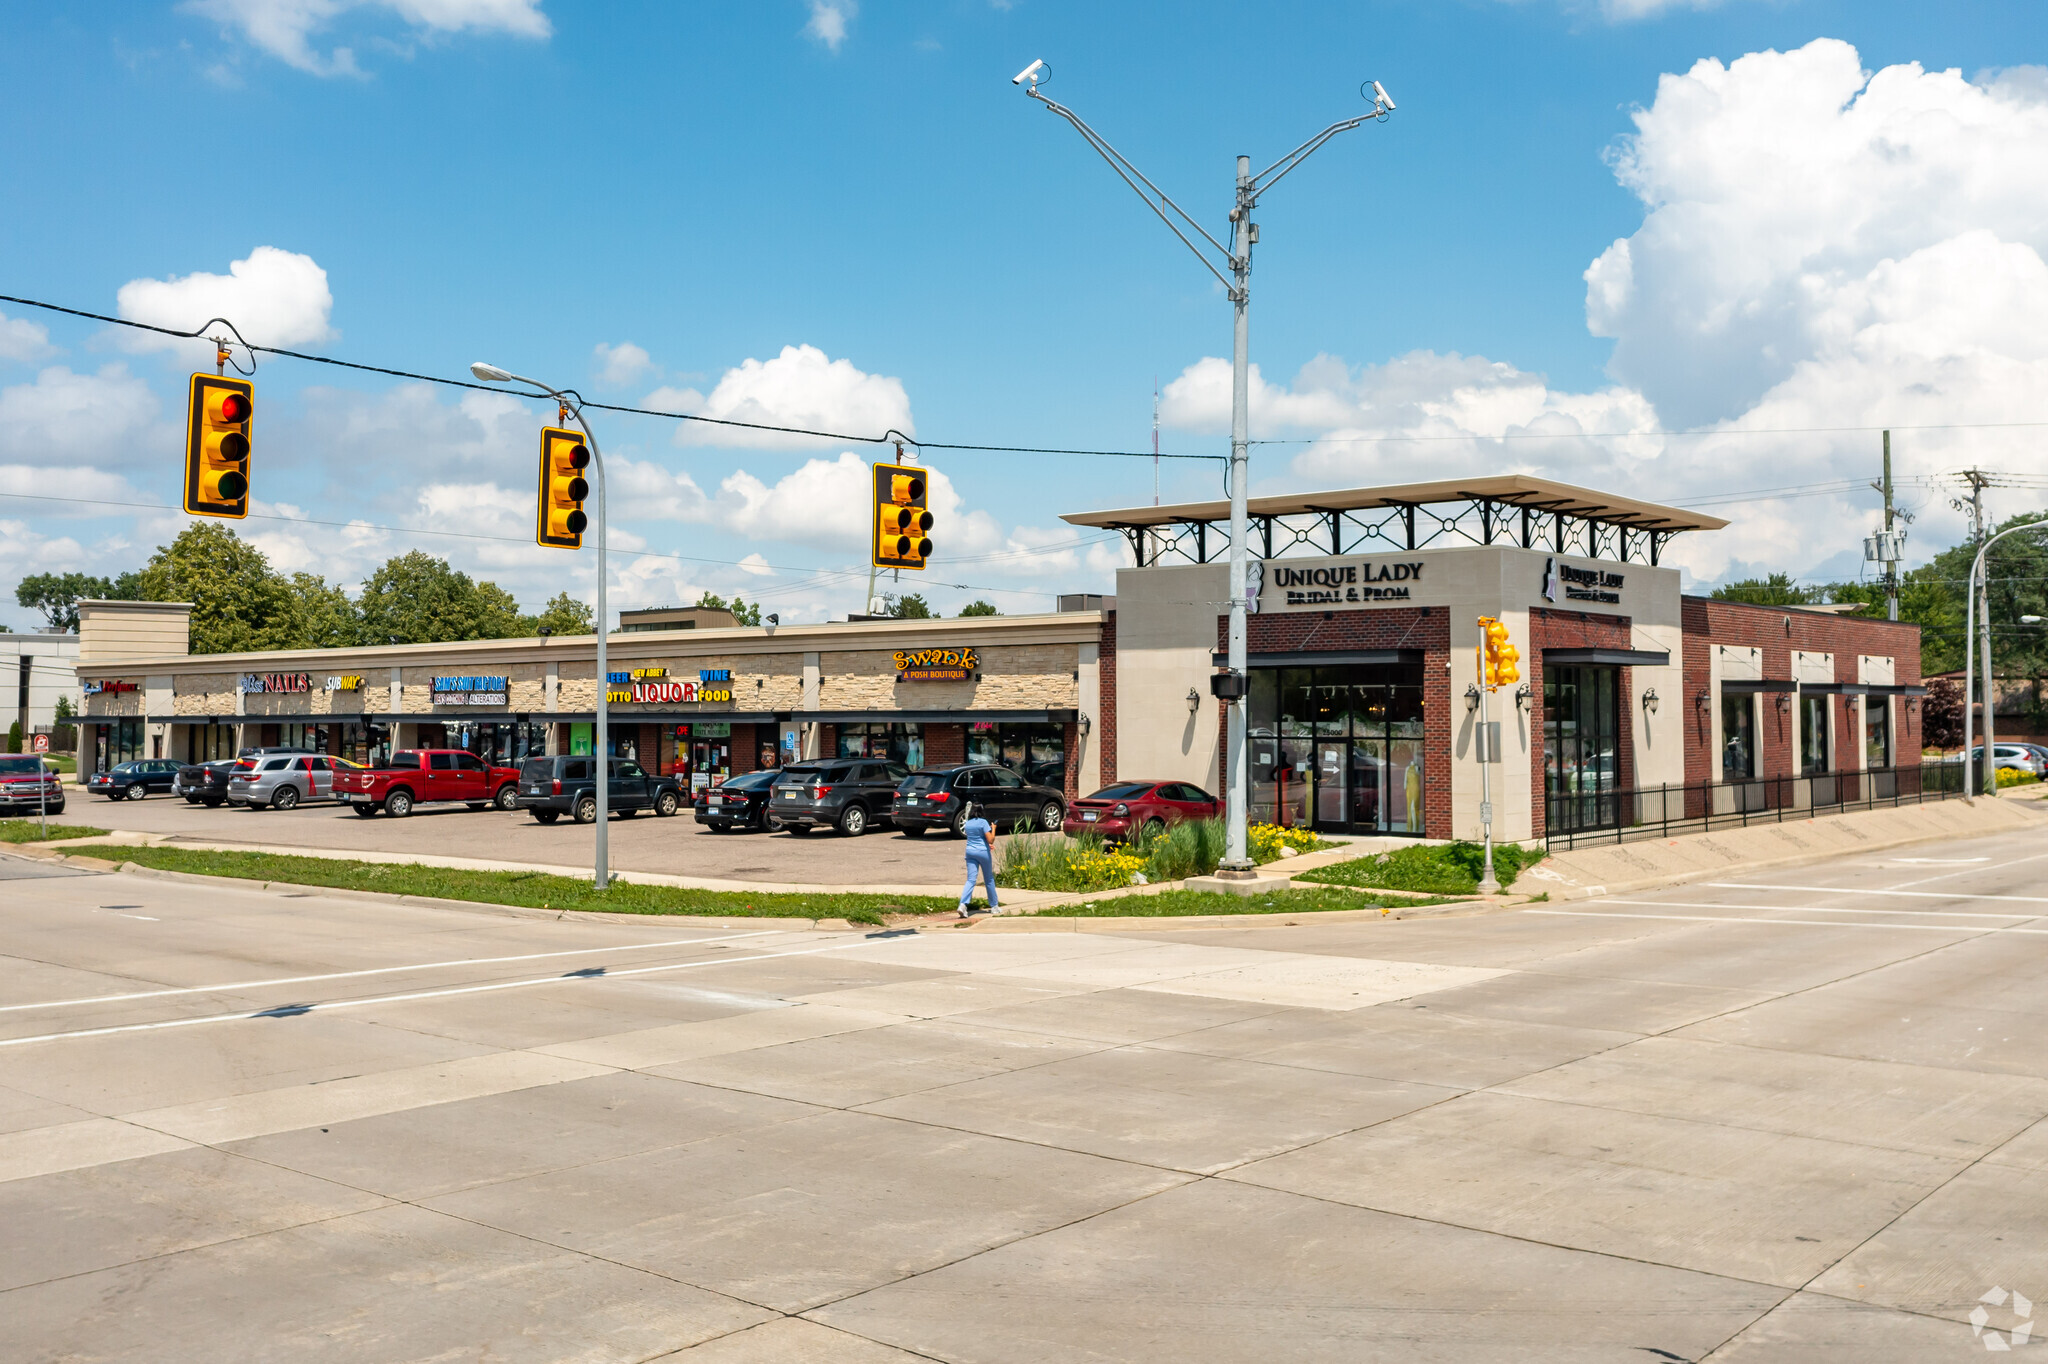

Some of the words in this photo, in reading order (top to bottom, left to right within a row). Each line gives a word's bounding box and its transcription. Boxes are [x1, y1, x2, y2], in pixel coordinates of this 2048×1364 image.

[1274, 566, 1357, 588] UNIQUE
[1363, 562, 1424, 583] LADY
[1286, 590, 1343, 605] BRIDAL
[1346, 587, 1361, 602] &
[1363, 586, 1411, 602] PROM
[892, 647, 976, 671] Swank
[633, 669, 646, 678] NEW
[646, 668, 664, 678] ABBEY
[699, 669, 730, 682] WINE
[903, 671, 909, 679] A
[910, 671, 928, 679] POSH
[930, 670, 965, 679] BOUTIQUE
[264, 673, 309, 693] NAILS
[325, 675, 360, 690] SUBWAY
[434, 676, 457, 691] SAM'S
[457, 676, 474, 691] SUIT
[474, 676, 507, 691] FACTORY
[469, 693, 506, 705] ALTERATIONS
[606, 691, 632, 703] OTTO
[632, 683, 695, 704] LIQUOR
[698, 689, 730, 702] FOOD
